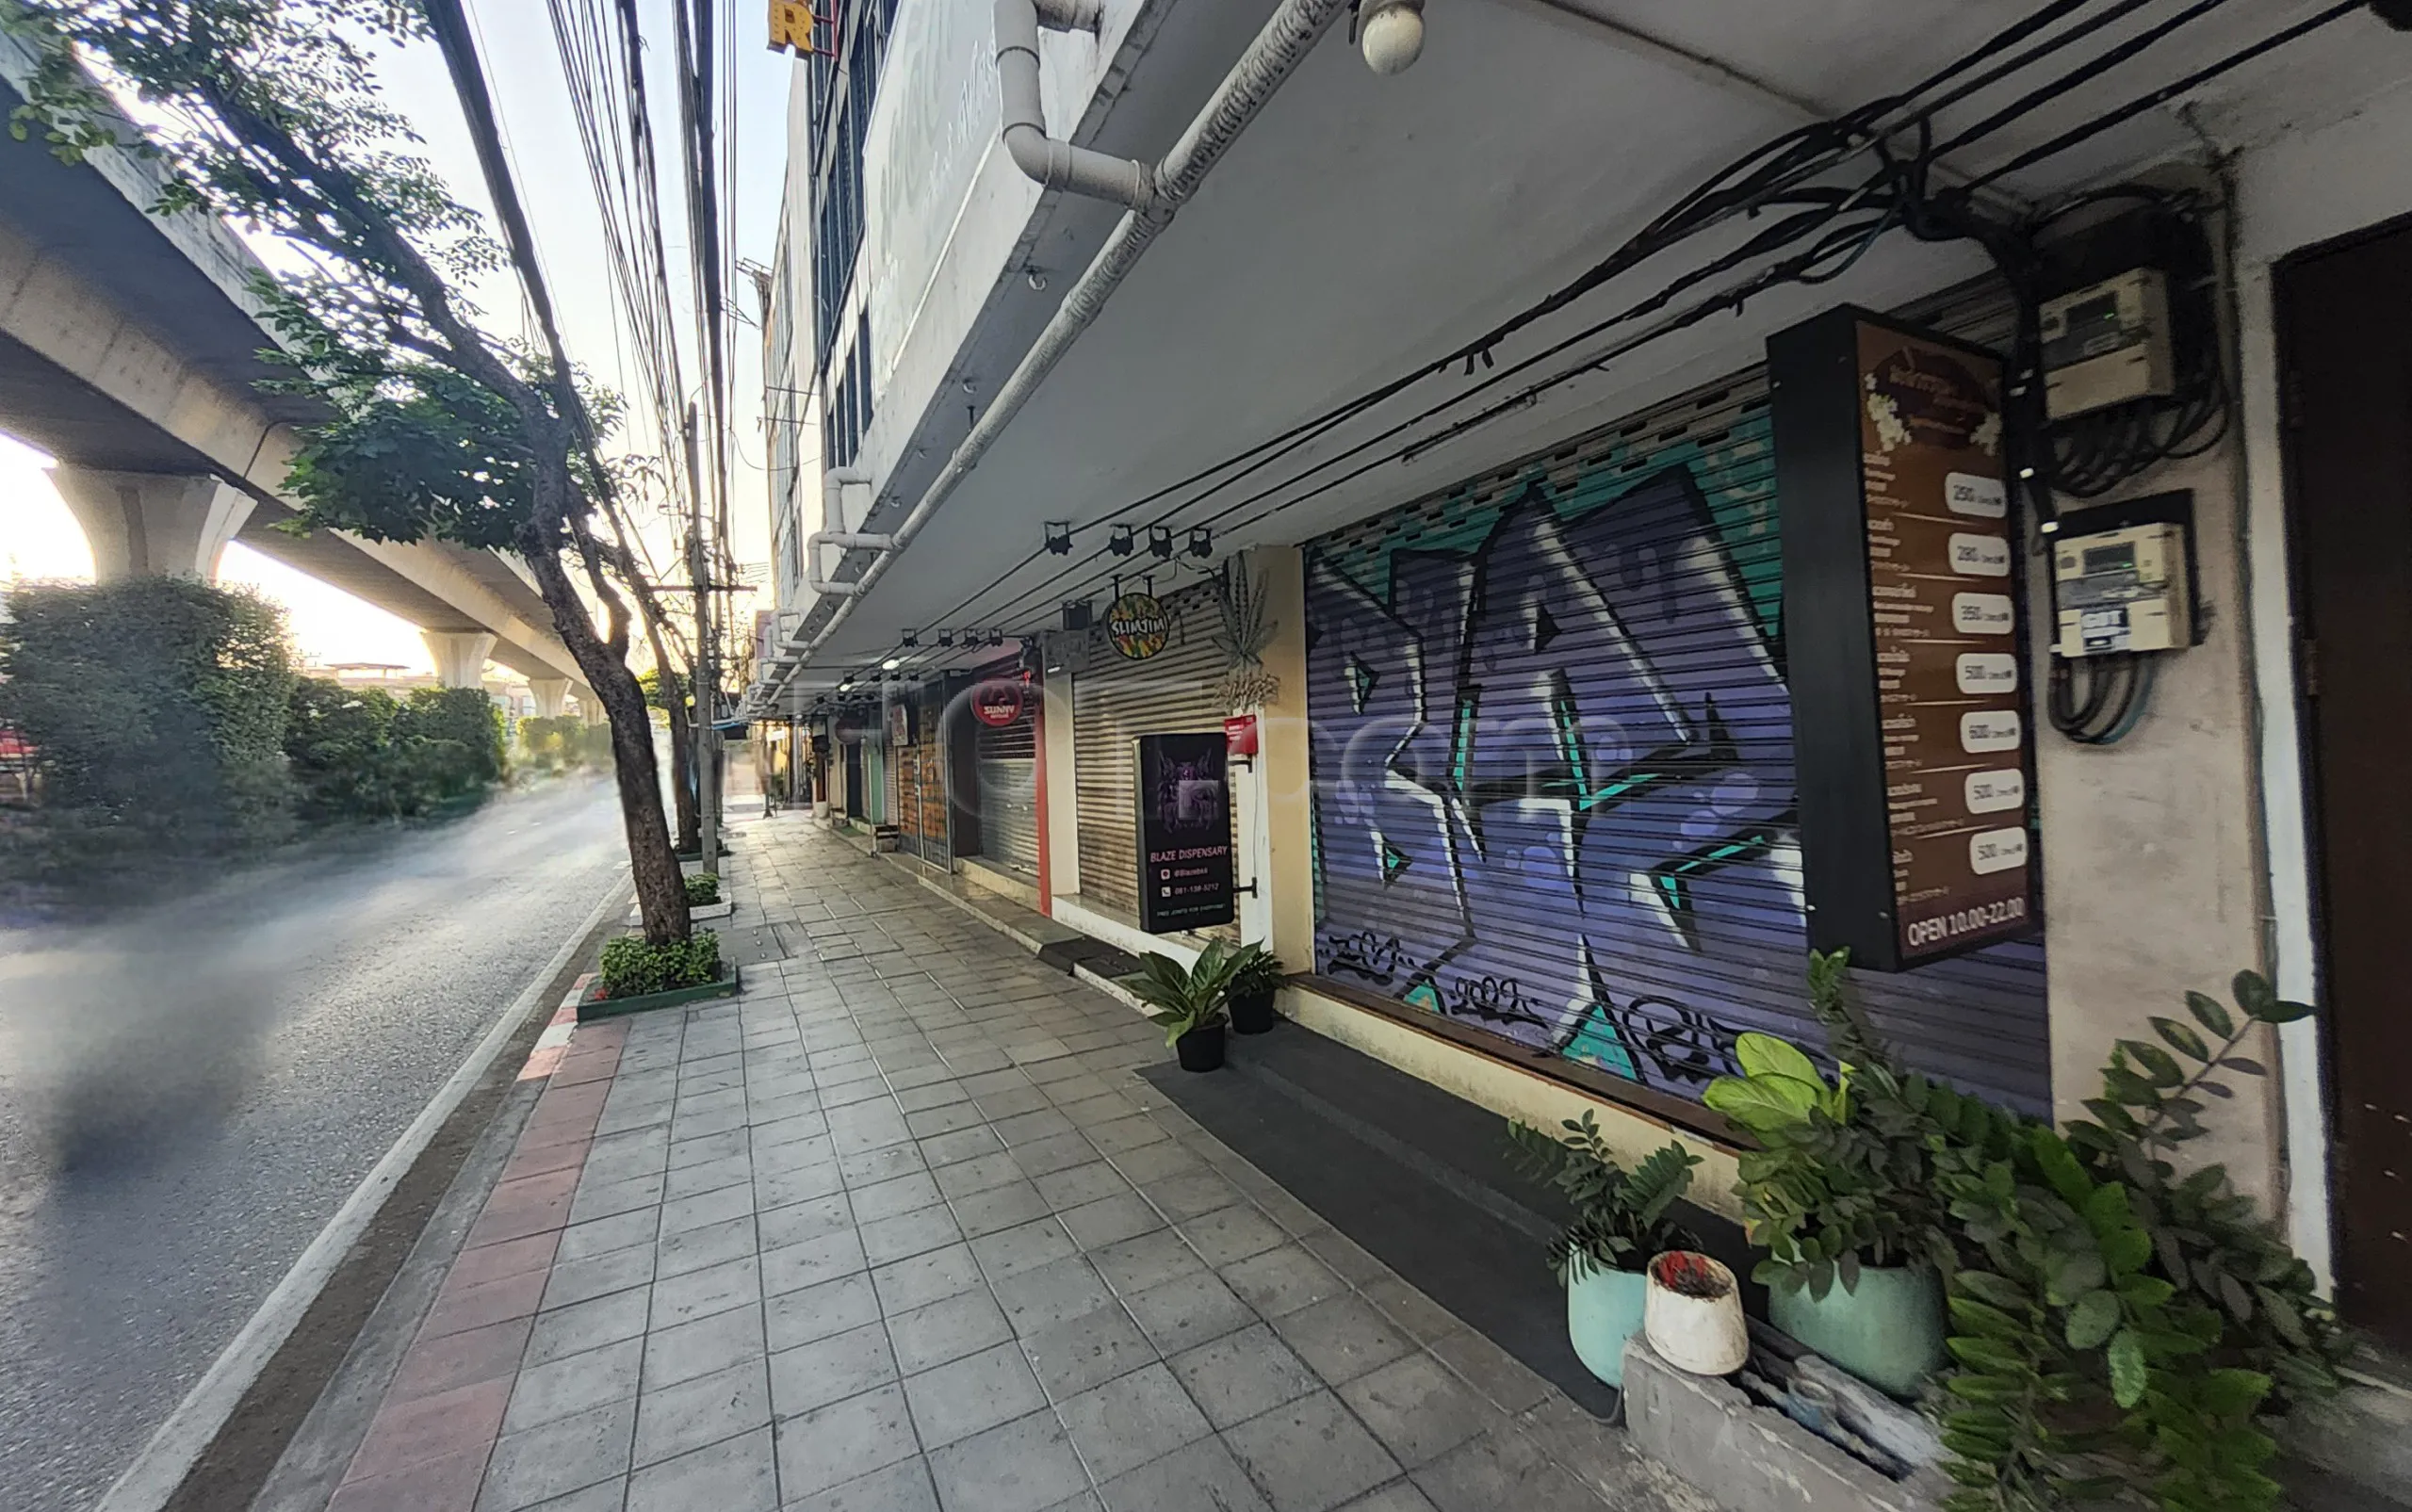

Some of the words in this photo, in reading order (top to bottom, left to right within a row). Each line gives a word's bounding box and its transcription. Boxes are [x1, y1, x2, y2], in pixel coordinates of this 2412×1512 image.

[983, 705, 1016, 715] SUNNY
[1150, 851, 1176, 863] BLAZE
[1179, 846, 1228, 859] DISPENSARY
[1908, 917, 1948, 947] OPEN
